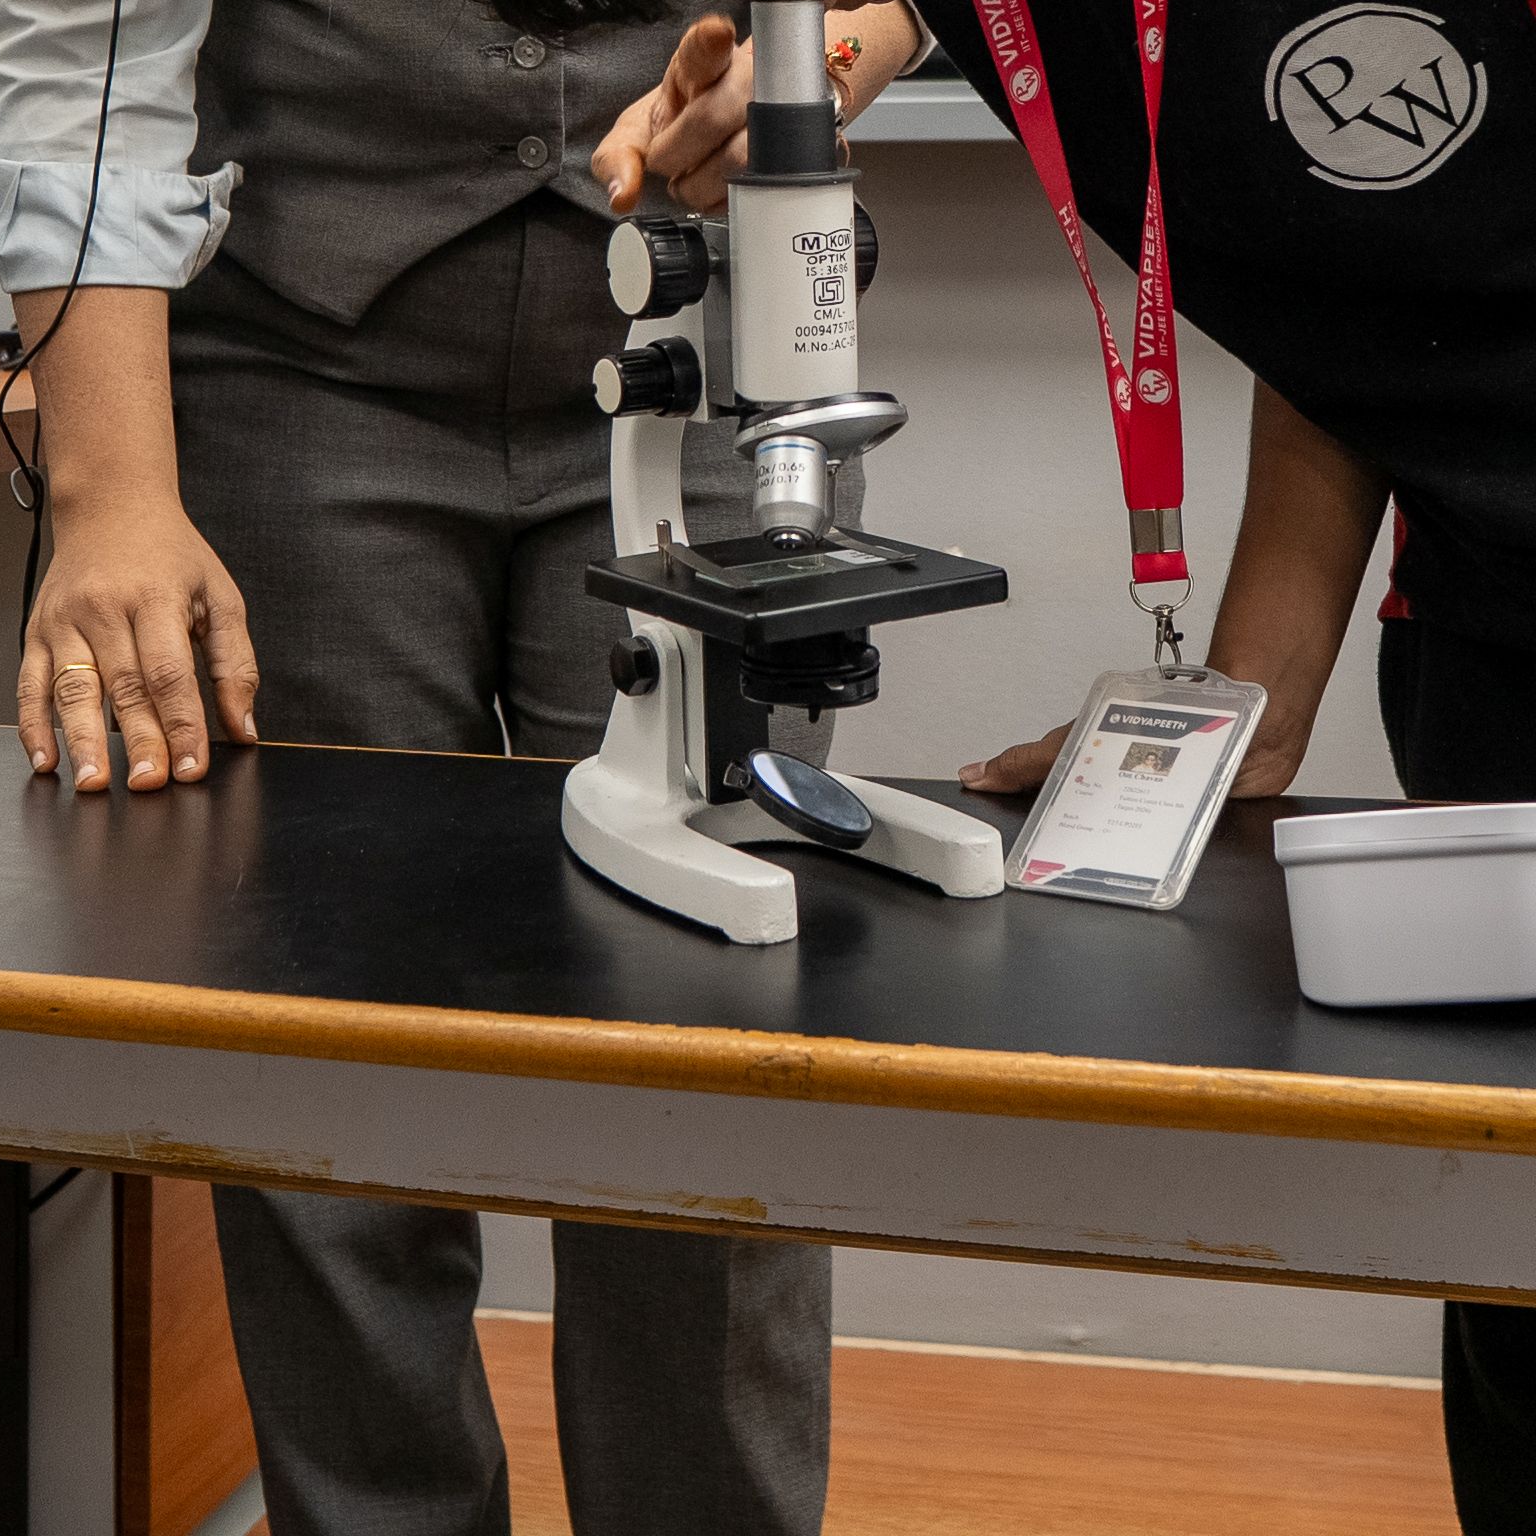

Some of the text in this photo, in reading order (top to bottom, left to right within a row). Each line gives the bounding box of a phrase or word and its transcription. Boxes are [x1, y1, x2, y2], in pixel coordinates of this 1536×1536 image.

[1014, 15, 1031, 53] IIT-JEE
[801, 237, 822, 251] M
[807, 252, 847, 265] OPTIK
[1155, 278, 1165, 307] NEET
[1158, 313, 1168, 356] IIT-JEE
[1121, 713, 1188, 731] VIDYAPEETH
